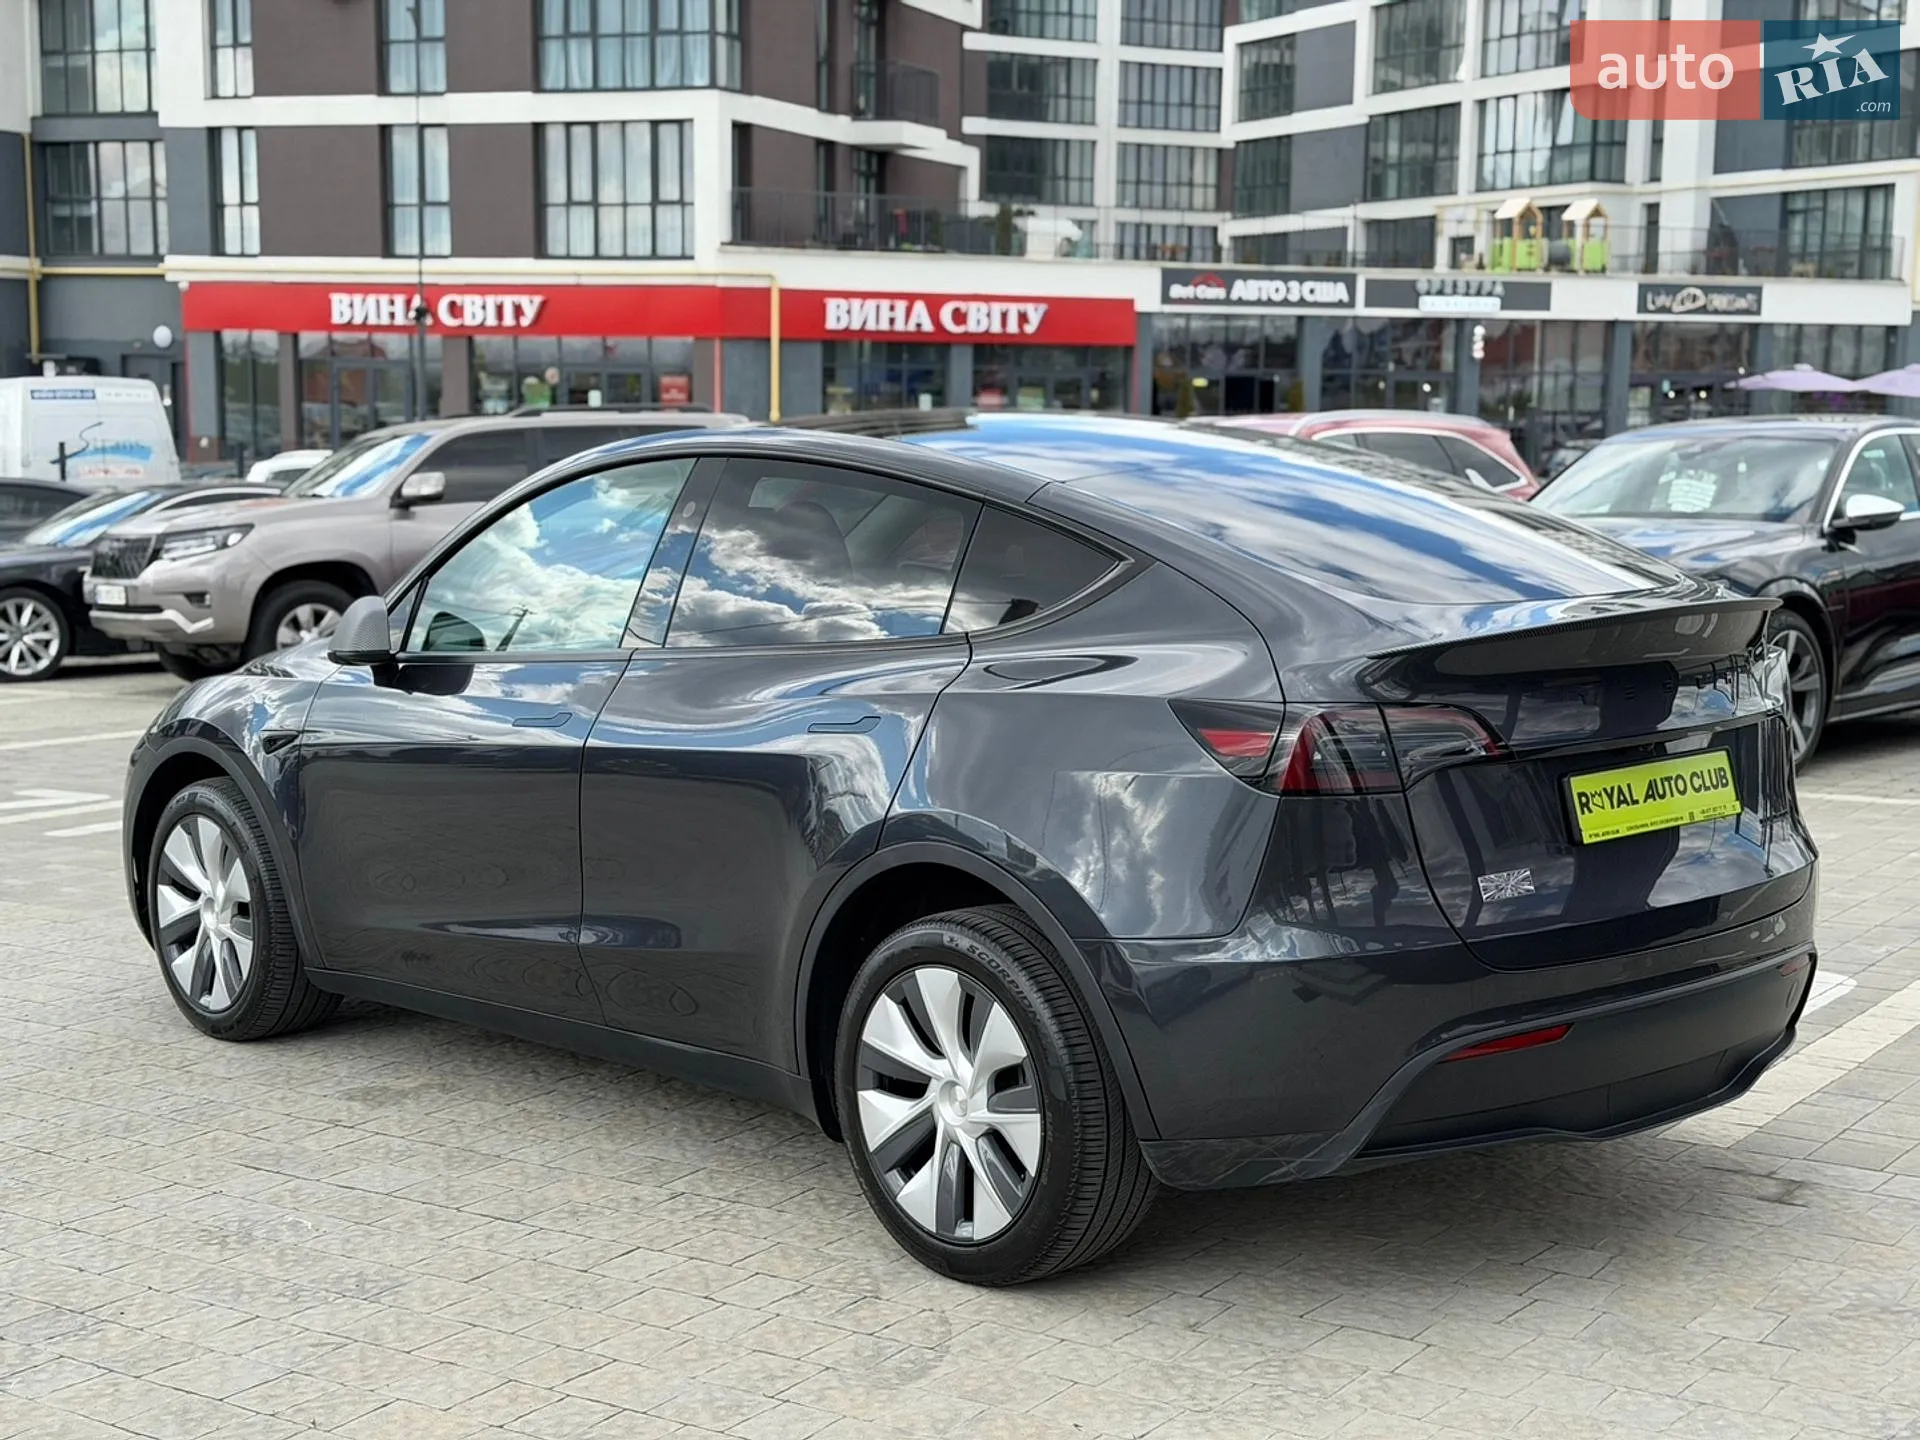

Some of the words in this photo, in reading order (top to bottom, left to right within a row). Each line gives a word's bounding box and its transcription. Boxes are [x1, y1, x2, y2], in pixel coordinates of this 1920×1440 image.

[1229, 279, 1287, 302] АВТО
[1301, 281, 1350, 303] США
[329, 293, 434, 326] ВИНА
[437, 293, 545, 327] СВІТУ
[824, 298, 935, 332] ВИНА
[939, 300, 1049, 334] СВІТУ
[1643, 773, 1688, 804] AUTO
[1689, 766, 1730, 793] CLUB
